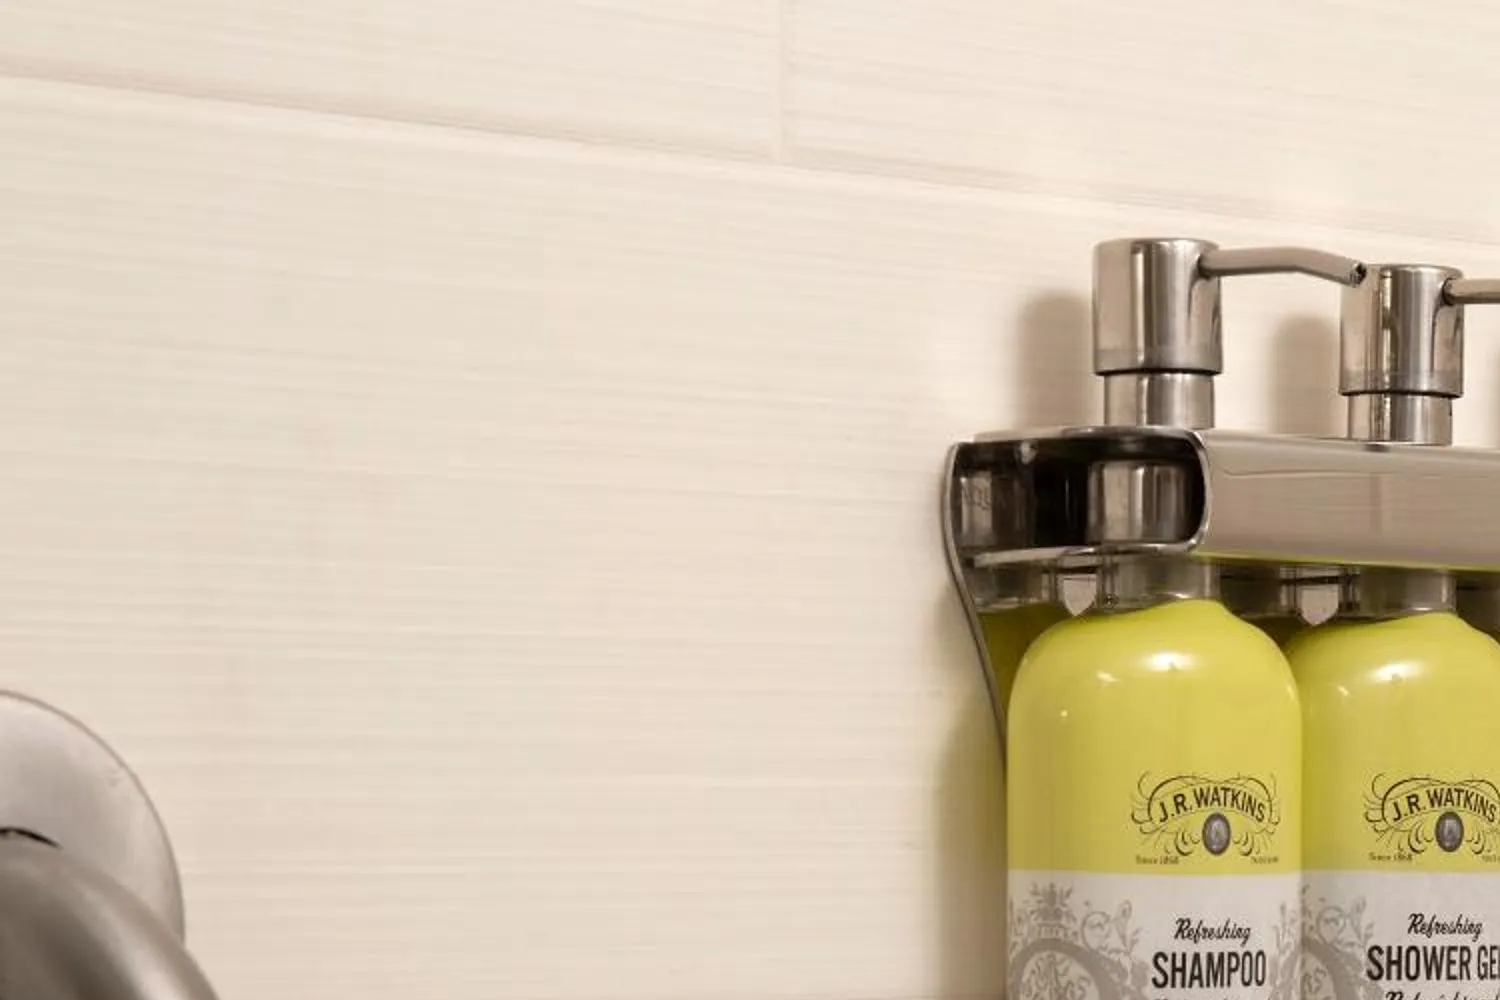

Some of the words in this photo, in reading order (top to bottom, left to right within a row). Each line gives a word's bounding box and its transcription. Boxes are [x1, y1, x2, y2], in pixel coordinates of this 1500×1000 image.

[1159, 793, 1192, 822] J.R.
[1193, 786, 1266, 822] WATKINS
[1392, 793, 1426, 822] J.R.
[1426, 788, 1496, 822] WATKINS
[1174, 917, 1251, 947] Refreshing
[1407, 913, 1483, 942] Refreshing
[1151, 950, 1266, 989] SHAMPOO
[1366, 945, 1471, 981] SHOWER
